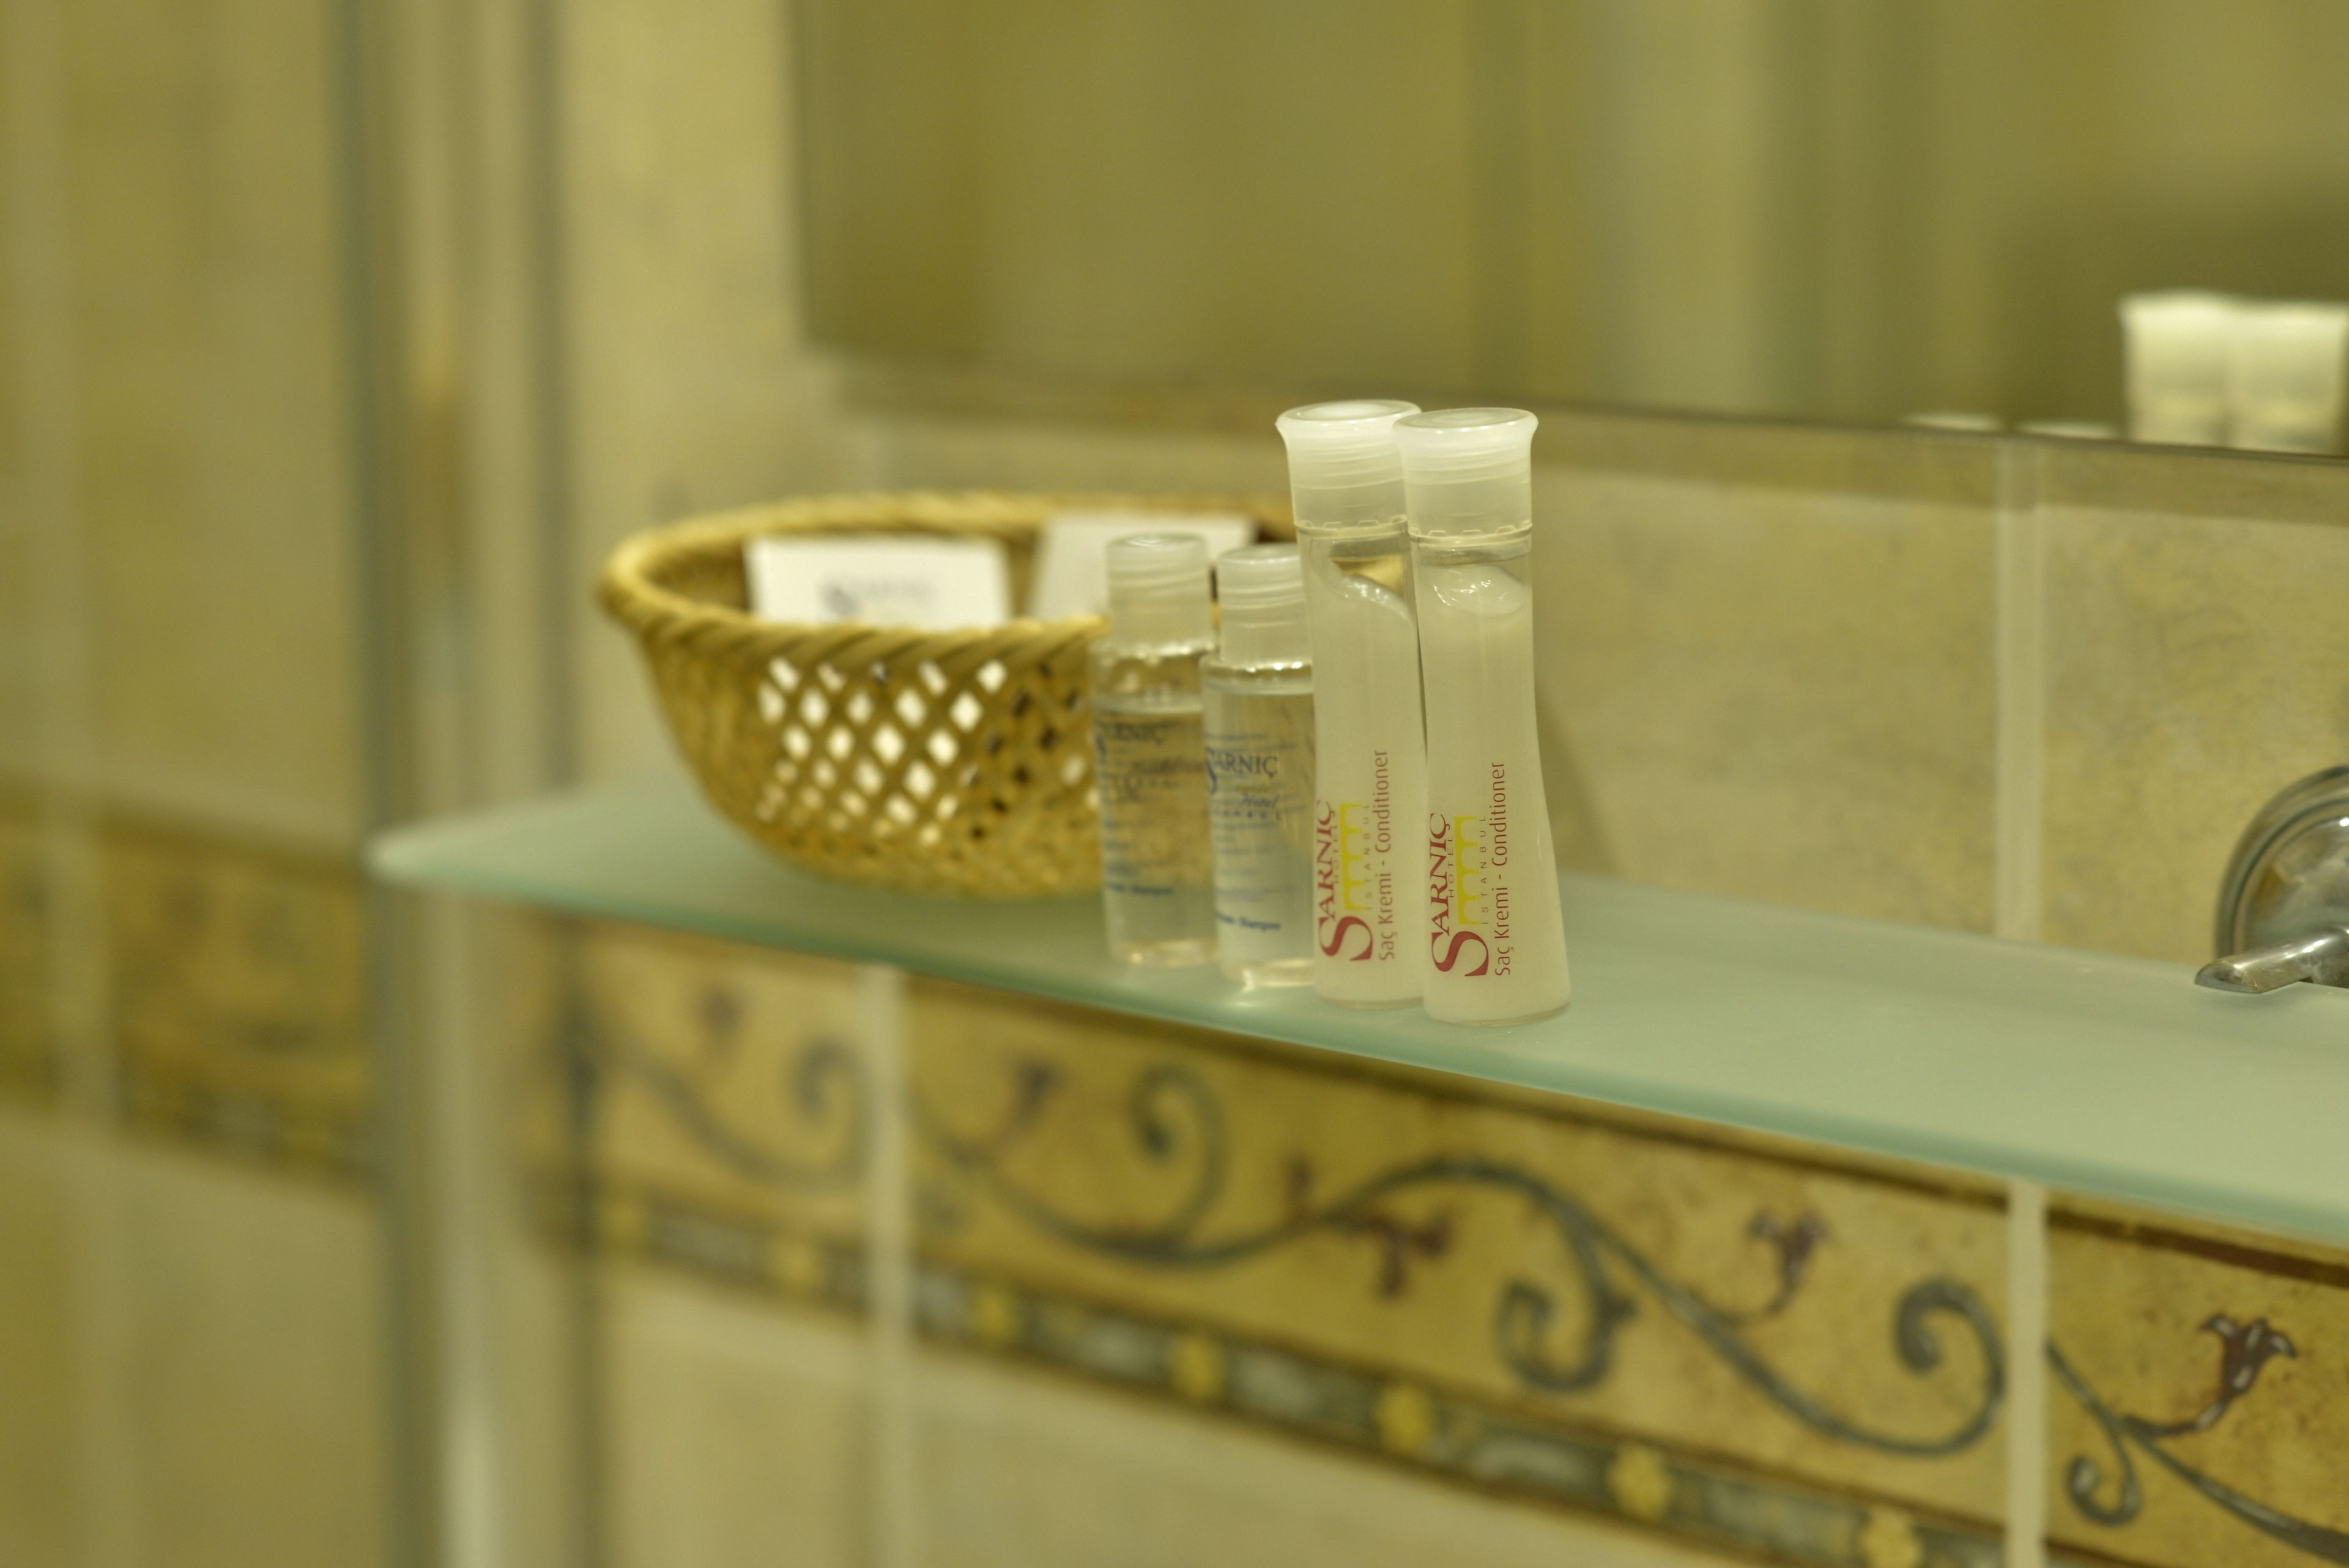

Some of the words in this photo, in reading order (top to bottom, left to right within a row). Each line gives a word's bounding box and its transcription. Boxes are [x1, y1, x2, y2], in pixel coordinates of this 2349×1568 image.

[1373, 751, 1390, 853] Conditioner
[1490, 762, 1508, 866] Conditioner
[1316, 800, 1373, 961] SARNIÇ
[1364, 805, 1372, 910] ISTANBUL
[1376, 873, 1393, 924] Kremi
[1430, 813, 1489, 976] SARNIÇ
[1479, 816, 1488, 924] ISTANBUL
[1379, 931, 1398, 961] Saç
[1491, 888, 1510, 938] Kremi
[1494, 946, 1515, 976] Saç
